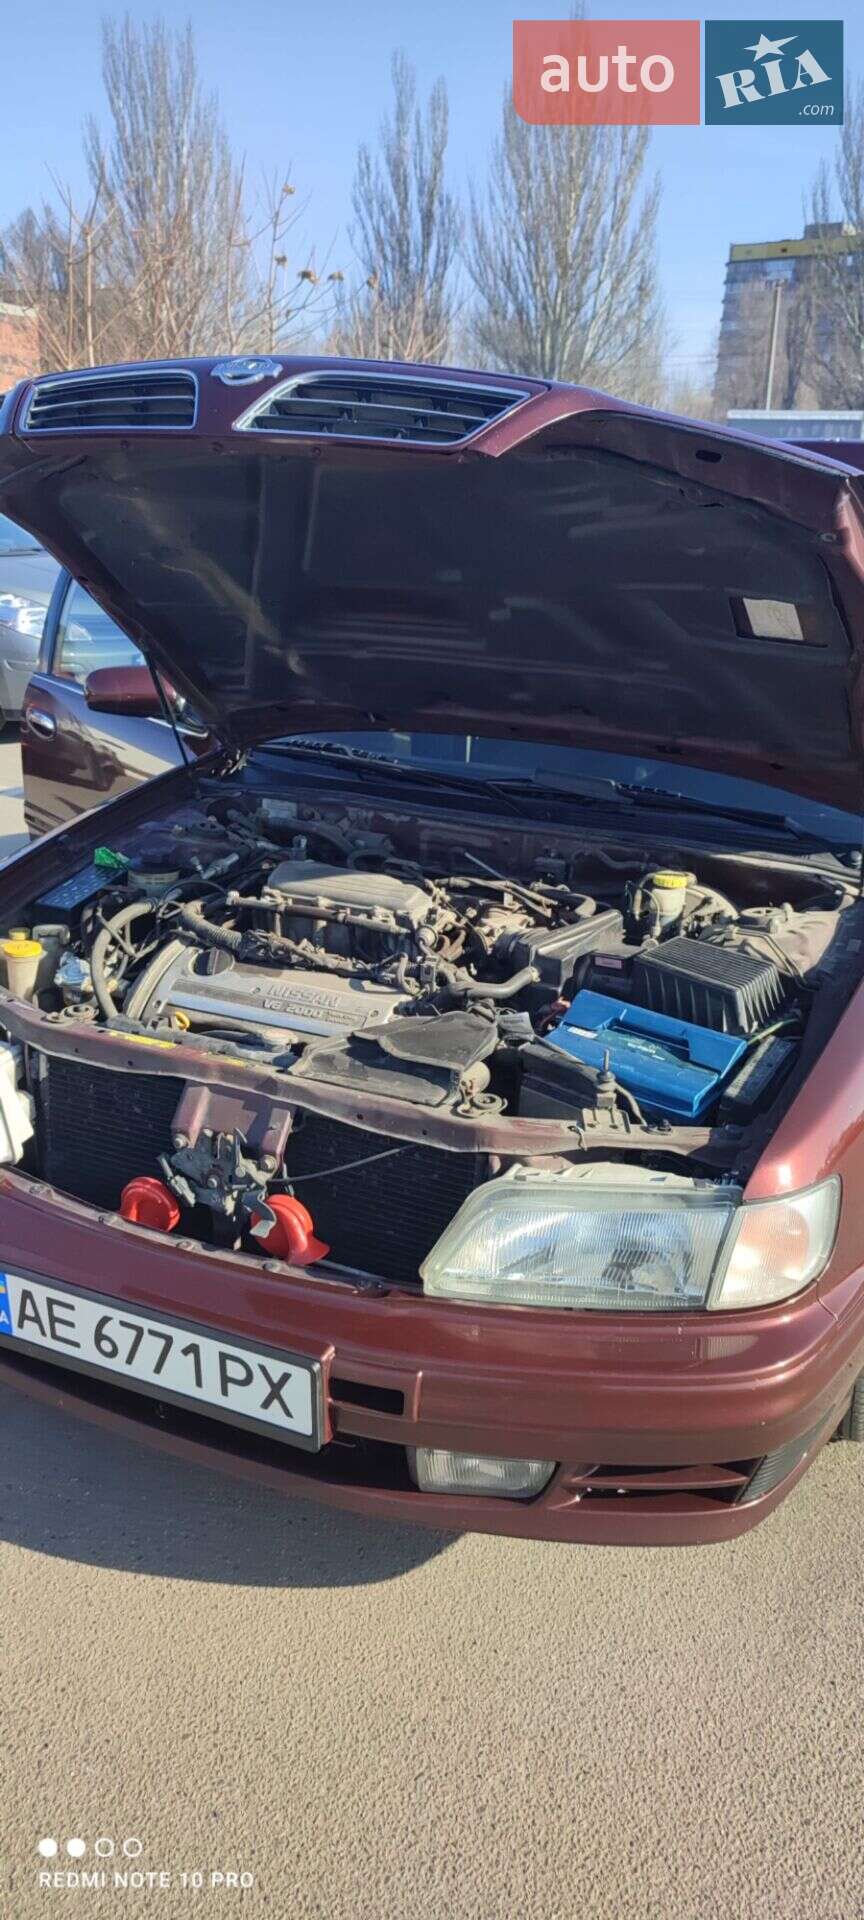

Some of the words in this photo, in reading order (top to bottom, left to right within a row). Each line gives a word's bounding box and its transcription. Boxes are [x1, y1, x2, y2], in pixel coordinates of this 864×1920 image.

[266, 984, 341, 1009] NISSAN
[285, 1003, 323, 1019] 2000
[17, 1289, 81, 1349] AE
[94, 1316, 203, 1389] 6771
[218, 1351, 294, 1419] PX
